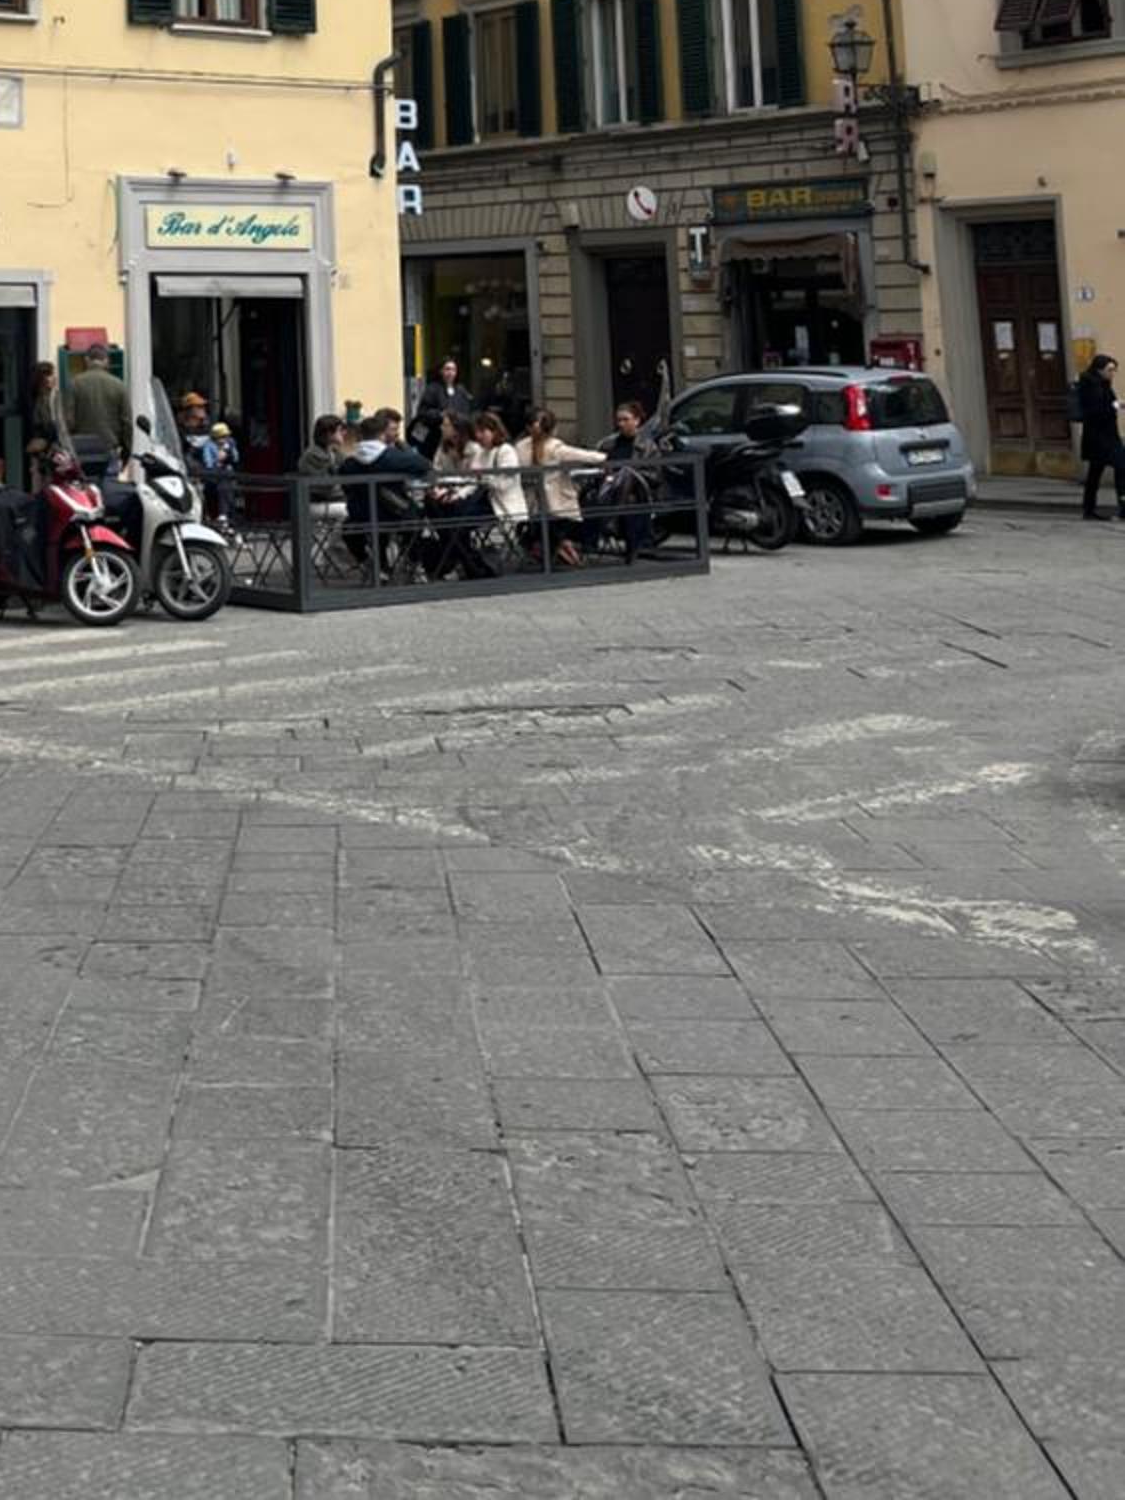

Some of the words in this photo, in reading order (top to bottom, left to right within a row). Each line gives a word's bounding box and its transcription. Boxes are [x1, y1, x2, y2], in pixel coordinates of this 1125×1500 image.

[394, 98, 422, 214] BAR
[747, 187, 812, 208] BAR
[157, 211, 202, 236] Bar
